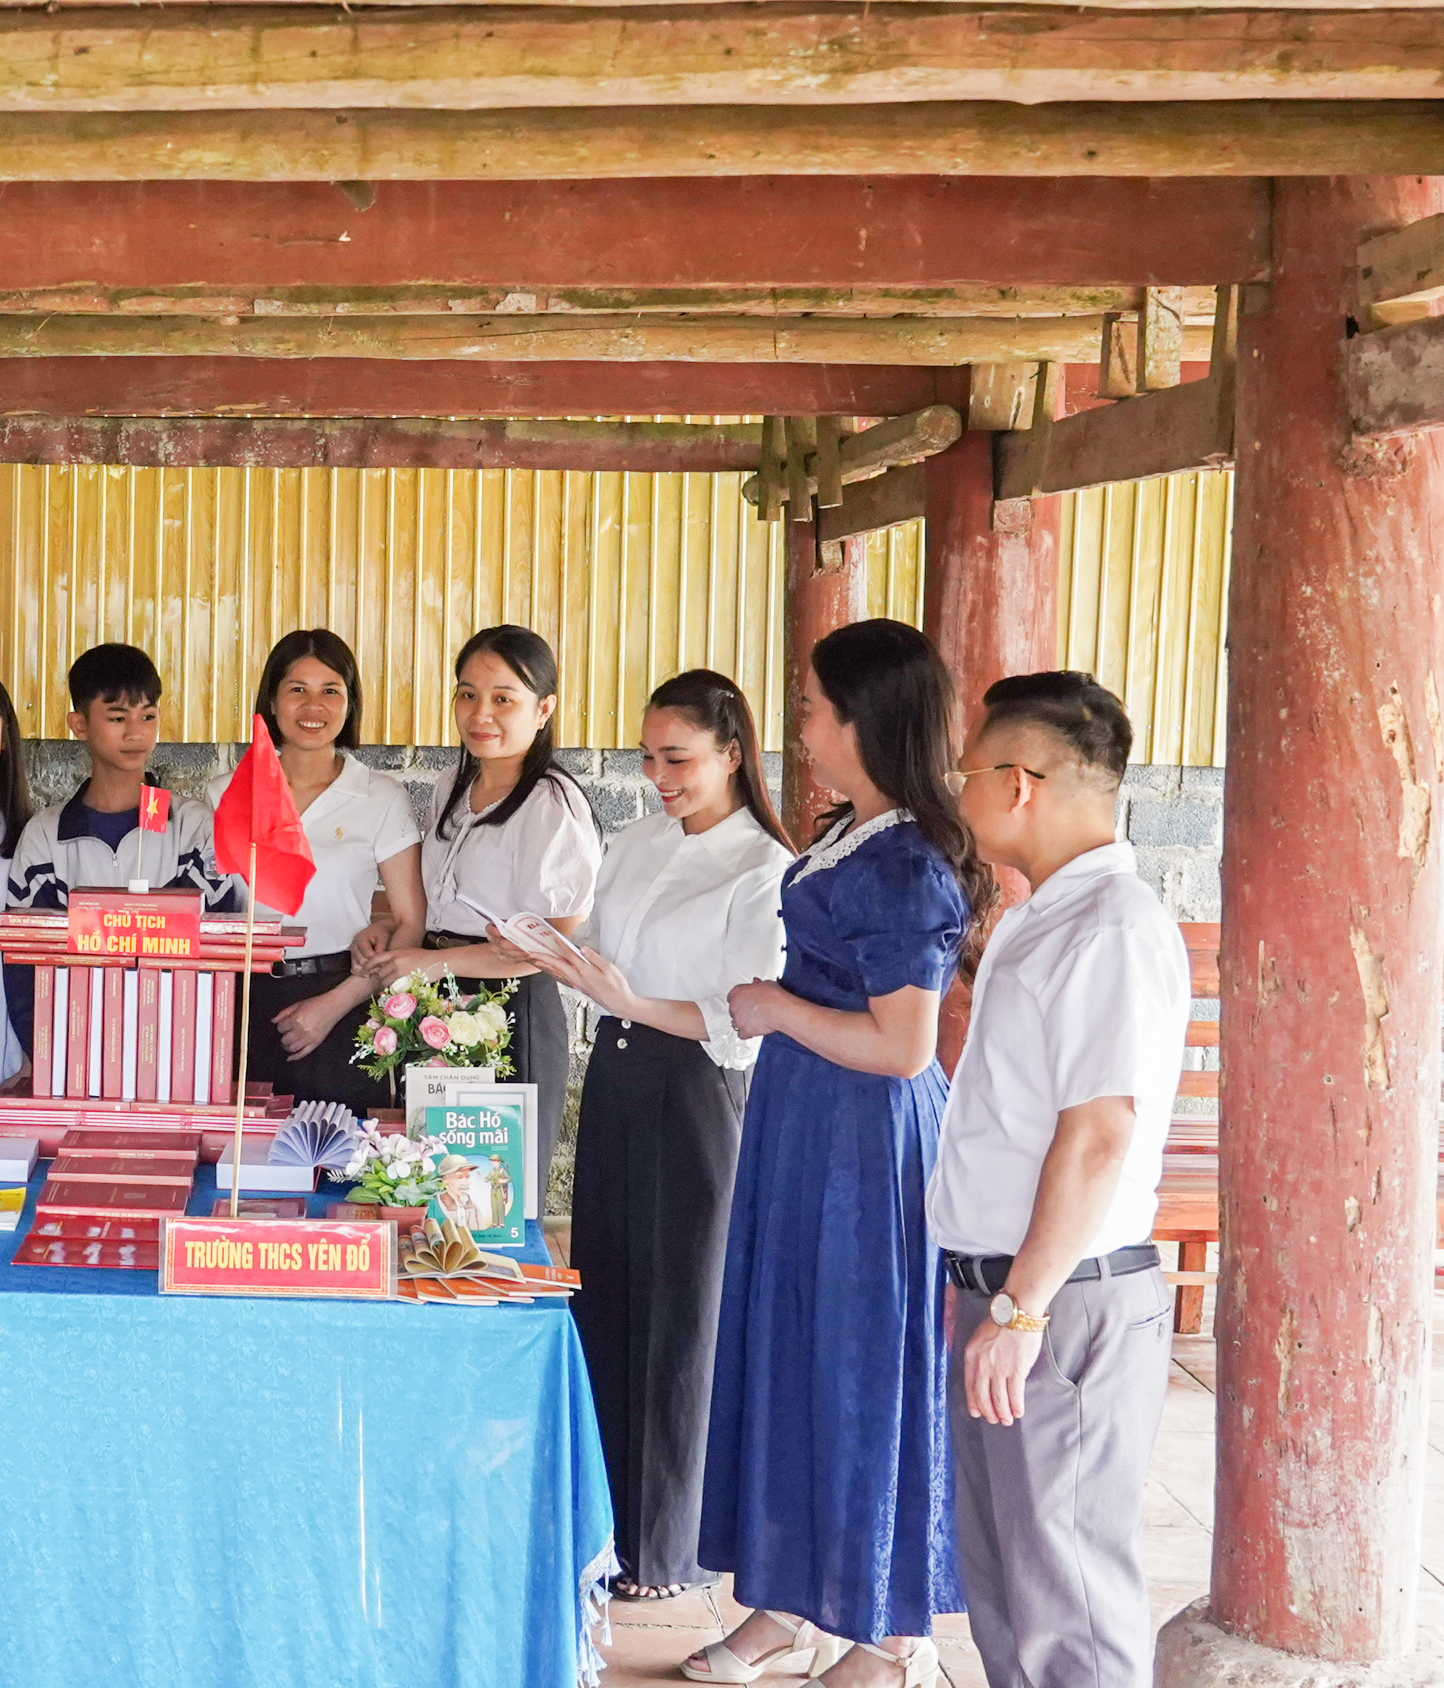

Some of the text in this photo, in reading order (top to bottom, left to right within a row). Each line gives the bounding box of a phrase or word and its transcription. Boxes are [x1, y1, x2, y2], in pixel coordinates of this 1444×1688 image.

[103, 911, 166, 931] CHỦ TỊCH
[77, 930, 102, 952] HỒ
[107, 932, 137, 953] CHÍ
[142, 936, 191, 955] MINH
[445, 1111, 476, 1129] Bác
[438, 1126, 509, 1148] sống mãi
[510, 1226, 519, 1238] 5
[185, 1233, 372, 1272] TRƯỜNG THCS YÊN ĐỔ
